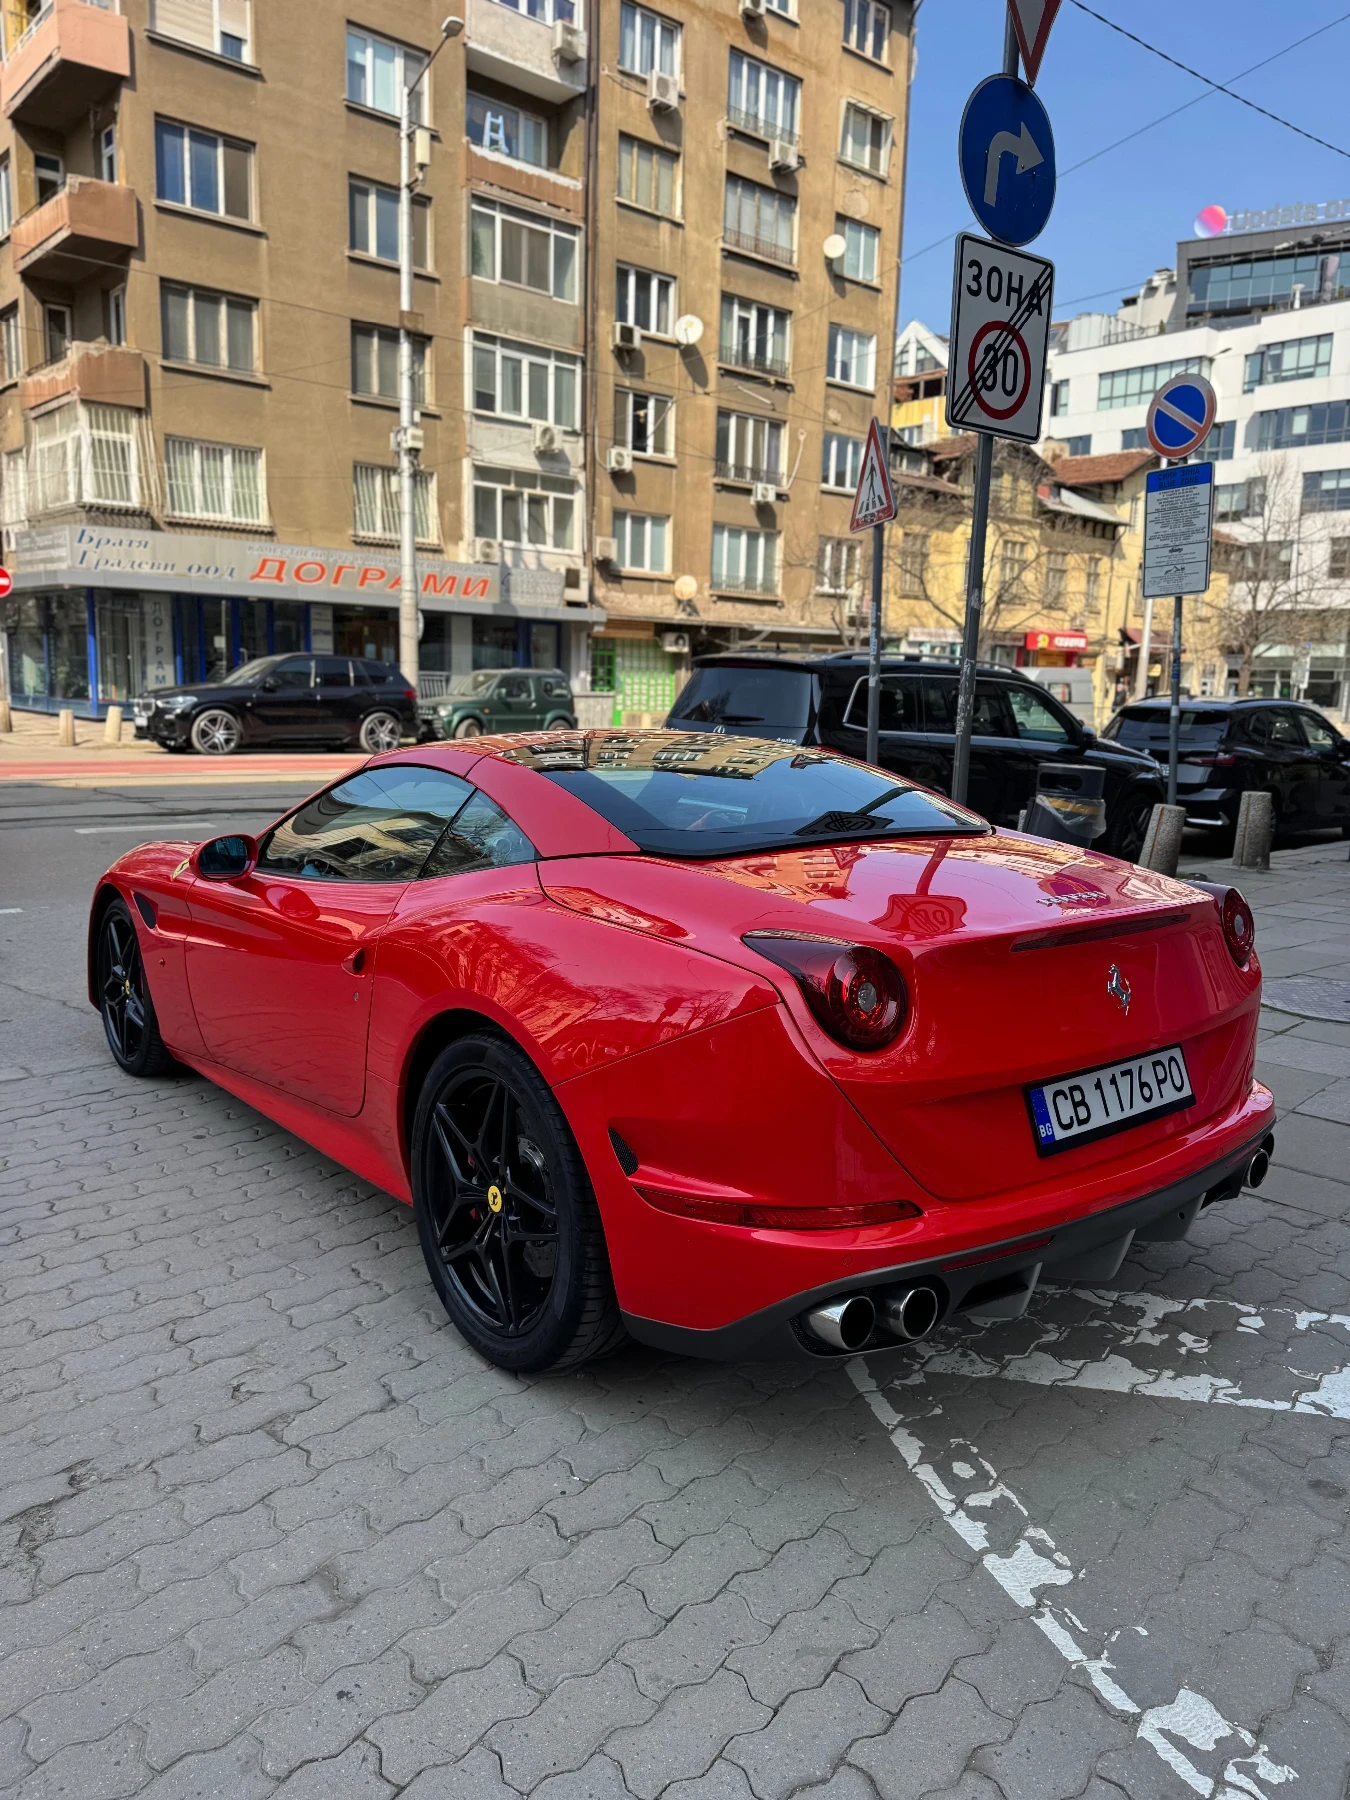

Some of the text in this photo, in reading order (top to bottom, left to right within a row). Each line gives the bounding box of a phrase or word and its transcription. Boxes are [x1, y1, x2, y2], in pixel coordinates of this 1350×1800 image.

[966, 259, 1043, 316] ЗОНА
[981, 343, 1019, 397] 30
[1158, 467, 1200, 481] СИНЯ ЗОНА
[1159, 475, 1200, 489] BLUE ZONE
[76, 528, 150, 549] Братя
[1052, 1055, 1185, 1131] CB 1176 PO
[1038, 1123, 1053, 1138] BG
